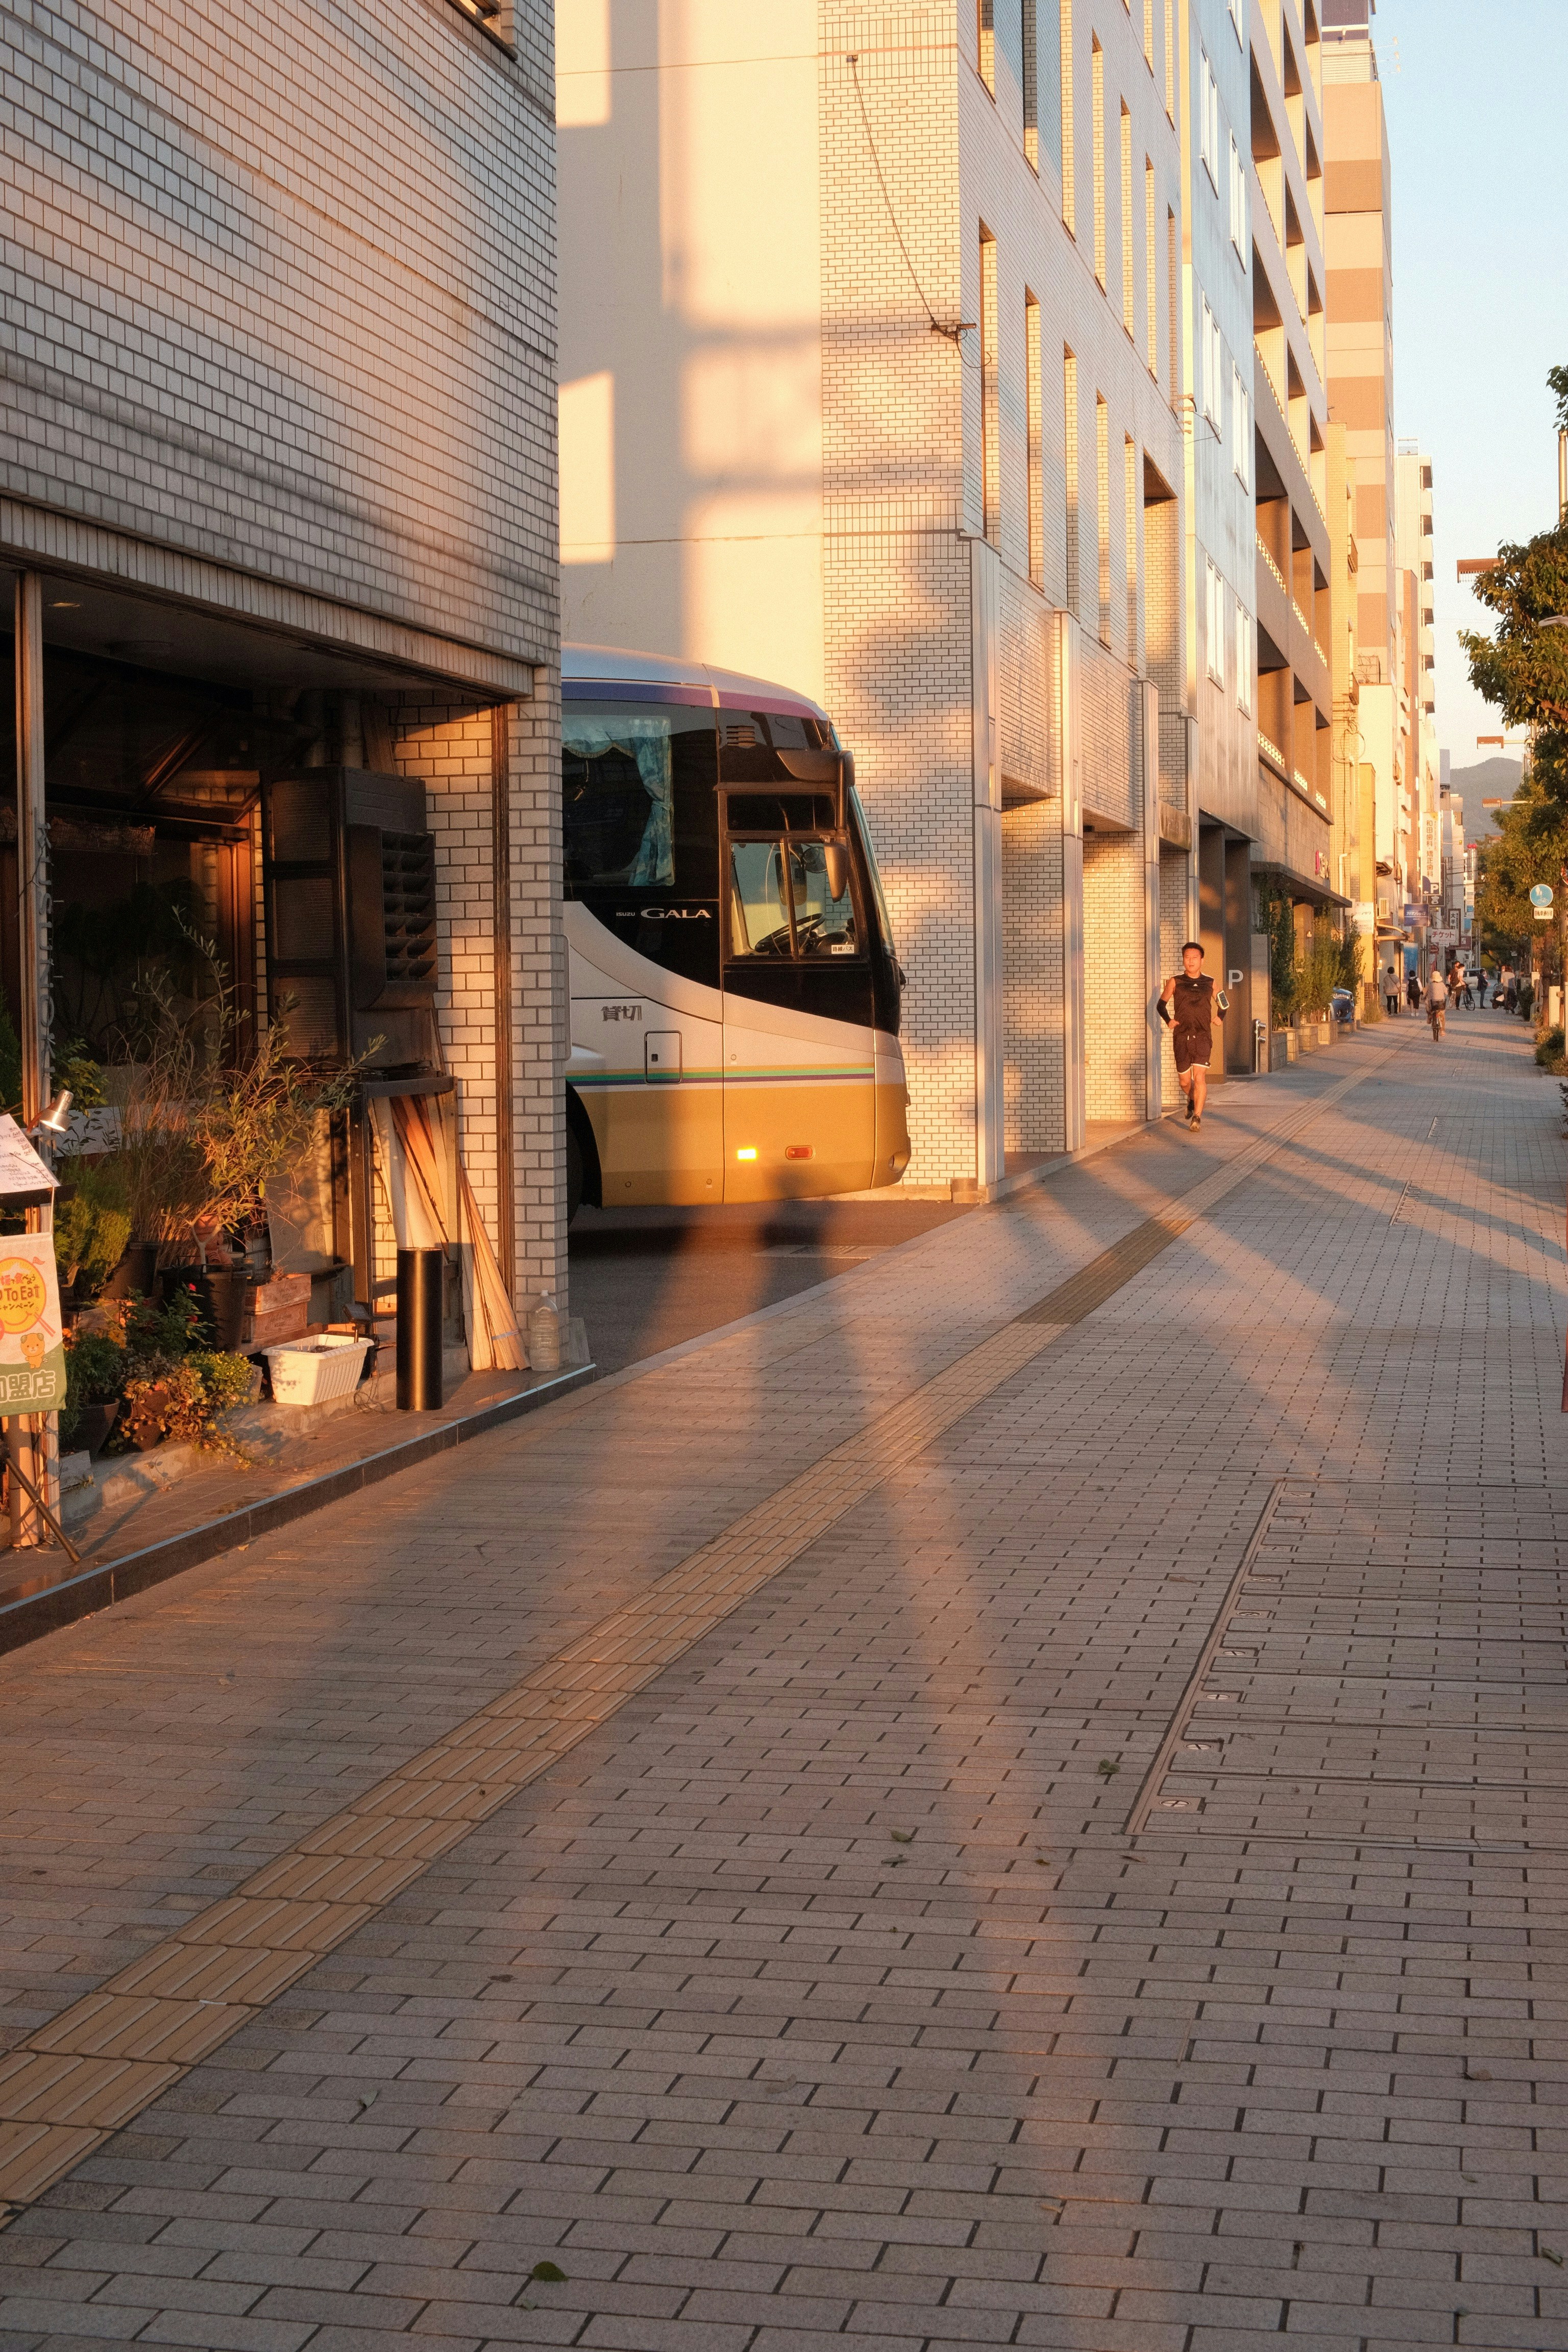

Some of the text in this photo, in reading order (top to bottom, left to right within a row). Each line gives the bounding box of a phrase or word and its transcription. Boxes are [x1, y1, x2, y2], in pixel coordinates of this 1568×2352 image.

[1431, 884, 1439, 893] P
[641, 908, 712, 919] GALA
[1228, 969, 1244, 990] P
[601, 1005, 642, 1021] 貸切
[4, 1288, 18, 1301] To
[0, 1302, 34, 1310] ャンペーン
